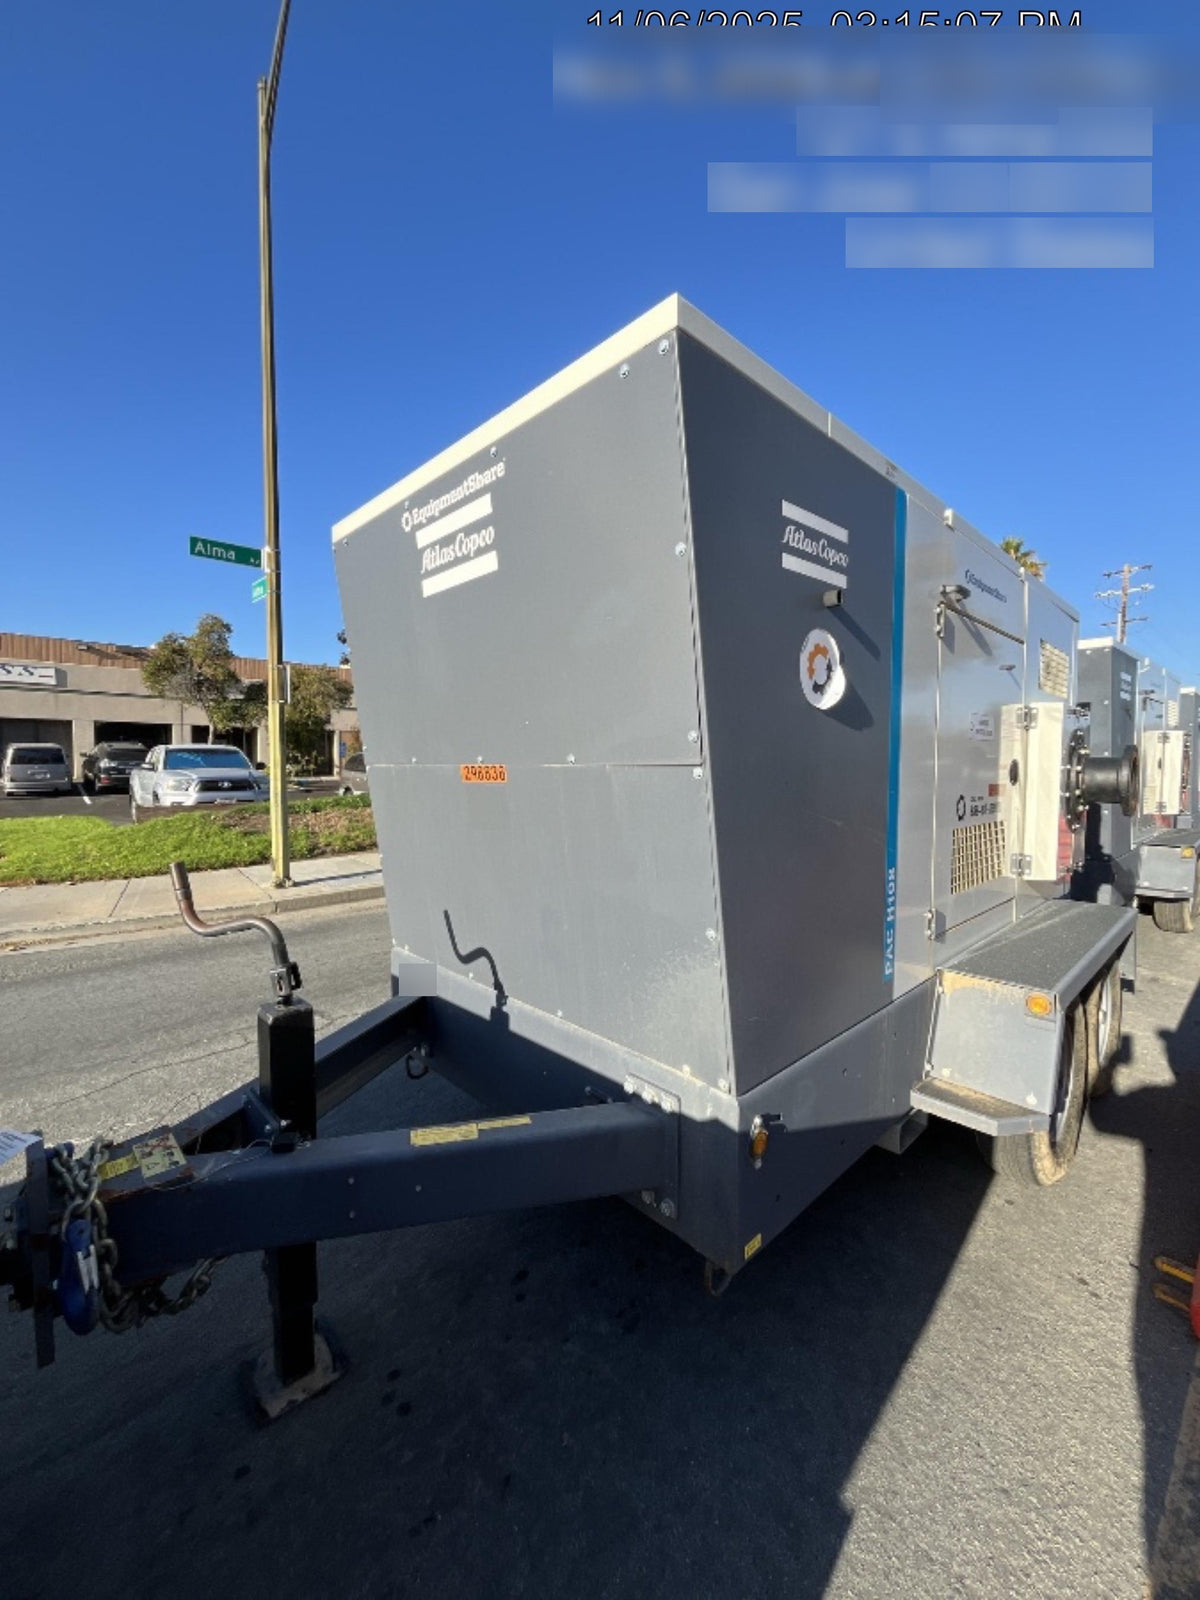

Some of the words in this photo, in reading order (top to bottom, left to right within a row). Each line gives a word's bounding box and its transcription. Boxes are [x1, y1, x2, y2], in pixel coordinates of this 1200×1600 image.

[412, 461, 506, 525] EquipmentShare
[194, 541, 236, 560] Alma
[420, 543, 455, 574] Atlas
[455, 526, 495, 557] Copco
[782, 525, 817, 555] Atlas
[819, 538, 849, 568] Copco
